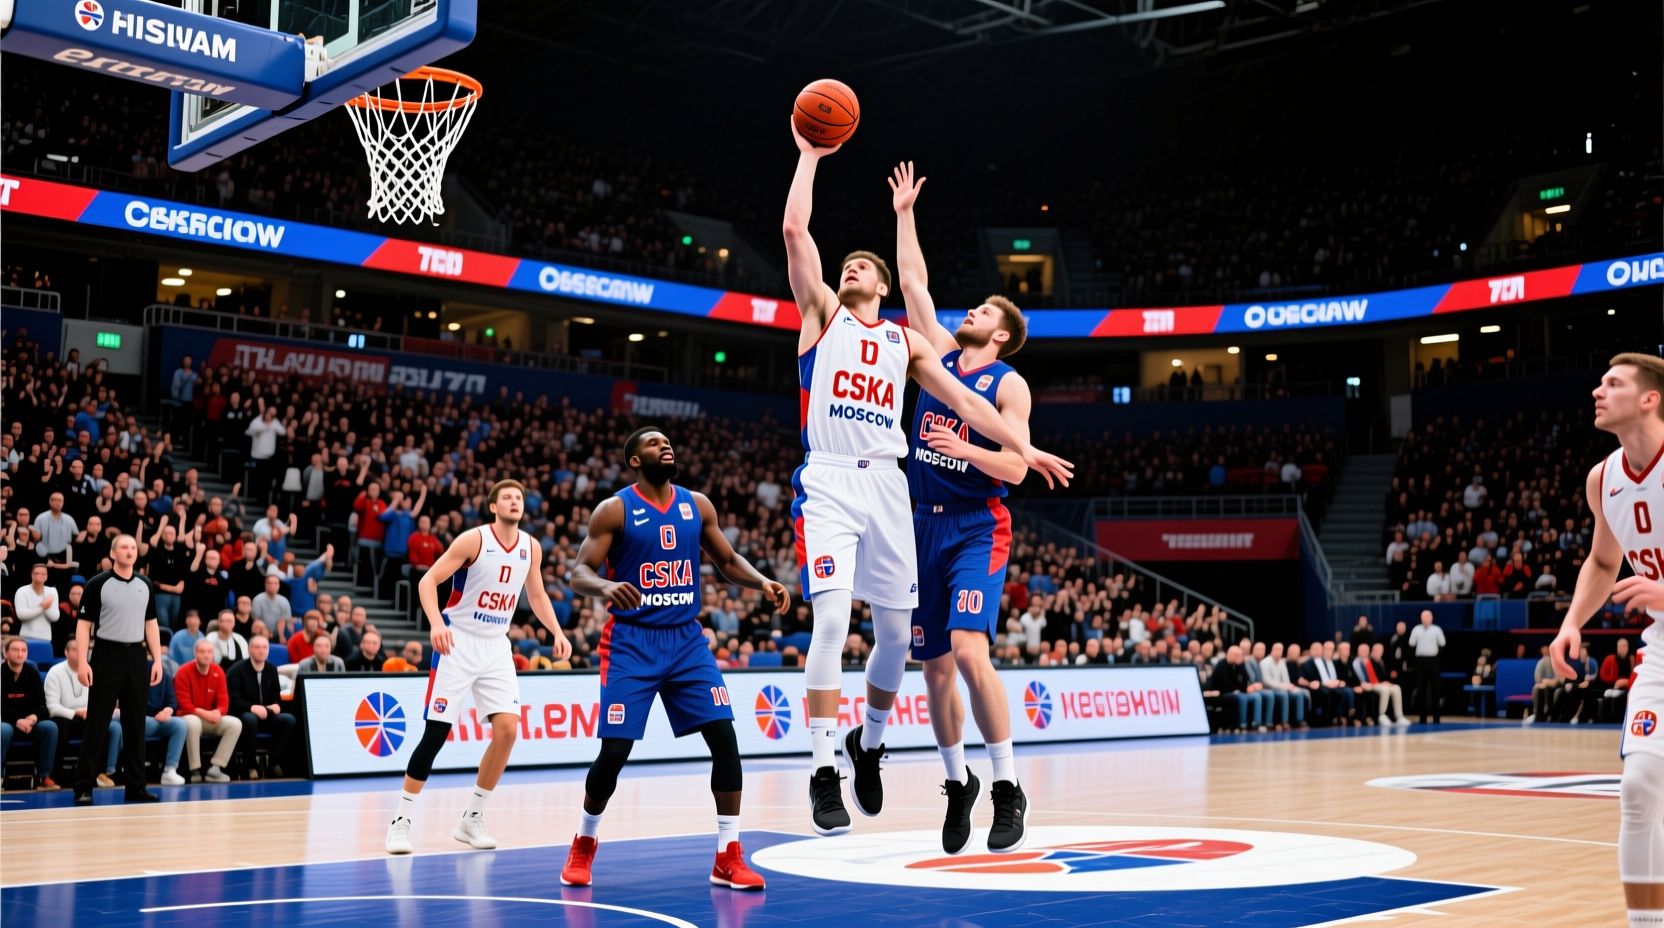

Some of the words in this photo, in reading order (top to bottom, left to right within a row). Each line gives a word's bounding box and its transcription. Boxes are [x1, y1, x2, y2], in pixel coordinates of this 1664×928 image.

[832, 370, 894, 411] CSKA
[829, 403, 893, 430] MOSCOW
[639, 559, 694, 589] CSKA
[477, 590, 516, 612] CSKA
